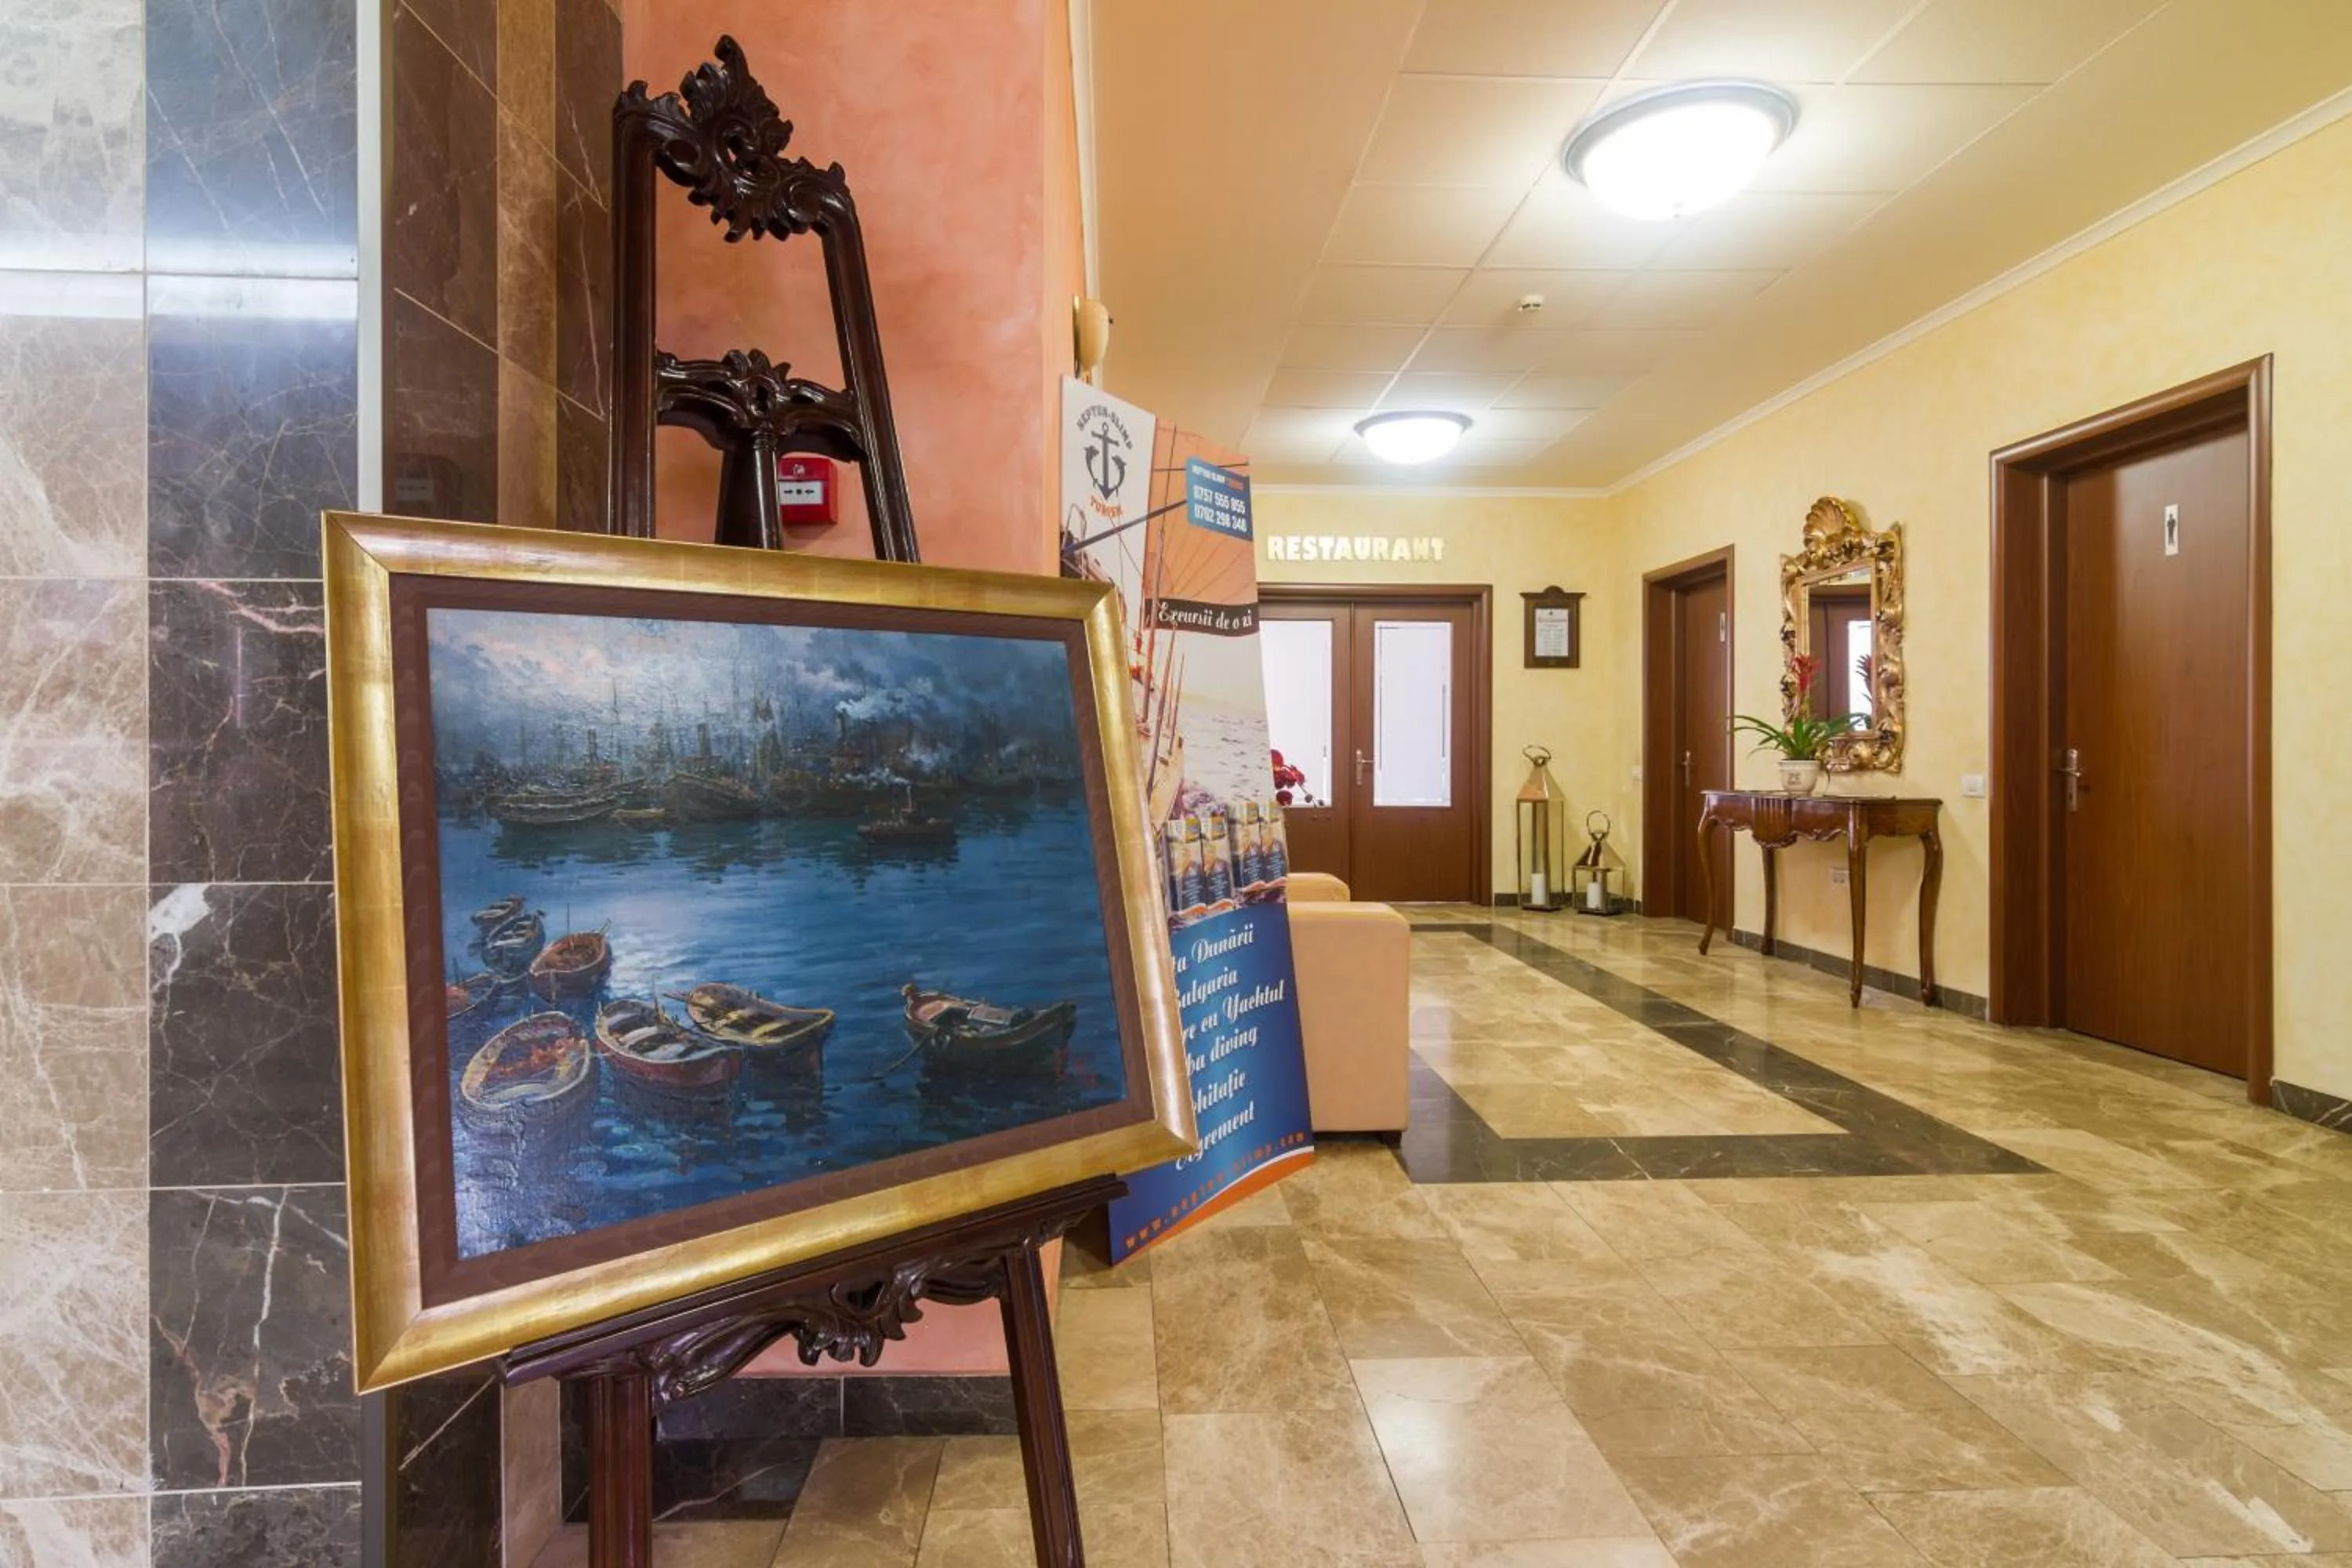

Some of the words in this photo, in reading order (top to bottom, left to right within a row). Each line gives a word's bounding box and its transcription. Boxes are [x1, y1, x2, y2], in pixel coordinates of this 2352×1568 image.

[1266, 535, 1446, 562] RESTAURANT
[1215, 611, 1230, 630] de
[1222, 978, 1285, 1024] Yachtul
[1210, 1027, 1258, 1062] diving
